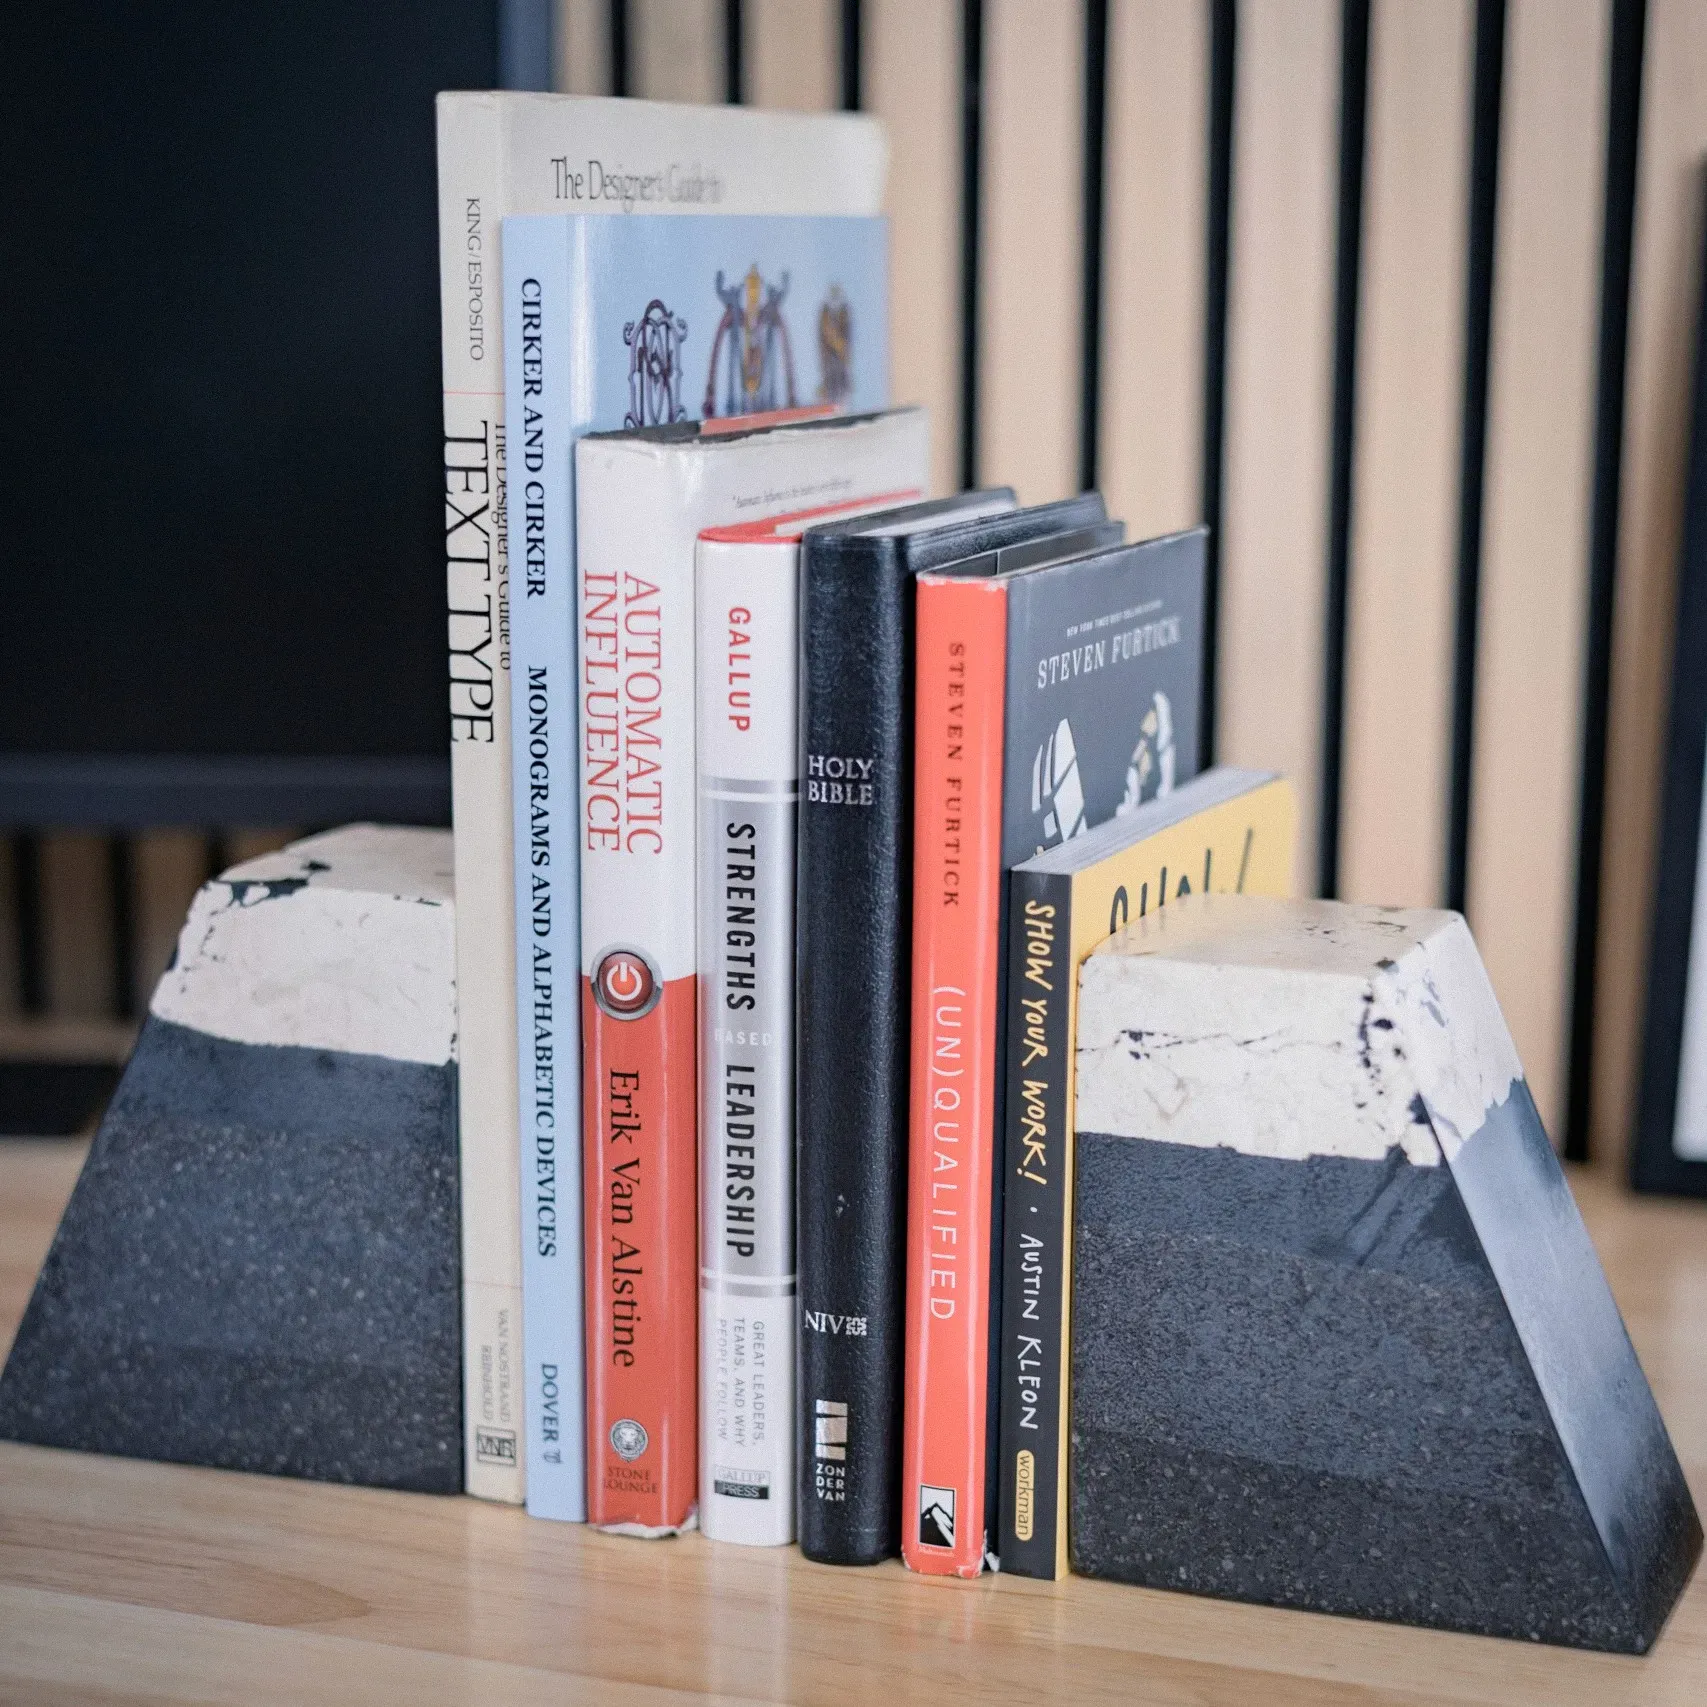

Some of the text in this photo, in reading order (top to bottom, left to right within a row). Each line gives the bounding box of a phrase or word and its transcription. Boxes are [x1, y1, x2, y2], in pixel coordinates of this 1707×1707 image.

[551, 156, 583, 199] The
[466, 198, 484, 361] KING/ESPOSITO
[522, 278, 546, 599] CIRKER AND CIRKER
[445, 420, 494, 743] TEXT TYPE
[584, 569, 620, 851] INFLUENCE
[625, 571, 662, 854] AUTOMATIC
[728, 606, 751, 732] GALLUP
[1037, 640, 1106, 689] STEVEN
[807, 755, 874, 779] HOLY
[807, 779, 874, 806] BIBLE
[943, 642, 965, 907] STEVEN FURTICK
[528, 665, 557, 1258] MONOGRAMS AND ALPHABETIC DEVICES
[726, 822, 756, 1011] STRENGTHS
[1017, 900, 1056, 1185] SHOW YOUR WORK!
[726, 1064, 755, 1258] LEADERSHIP
[931, 986, 966, 1320] (UN)QUALIFIED
[610, 1069, 643, 1368] Erik Van Alstine
[733, 1317, 746, 1447] TEAMS, AND WHY
[752, 1321, 765, 1445] GREAT LEADERS,
[804, 1310, 845, 1334] NIV
[1018, 1233, 1044, 1430] AUSTIN KLEON
[541, 1363, 559, 1442] DOVER
[723, 1483, 760, 1498] PRESS
[816, 1463, 845, 1476] ZON
[816, 1475, 845, 1489] DER
[816, 1488, 845, 1501] VAN
[1018, 1455, 1034, 1535] workman
